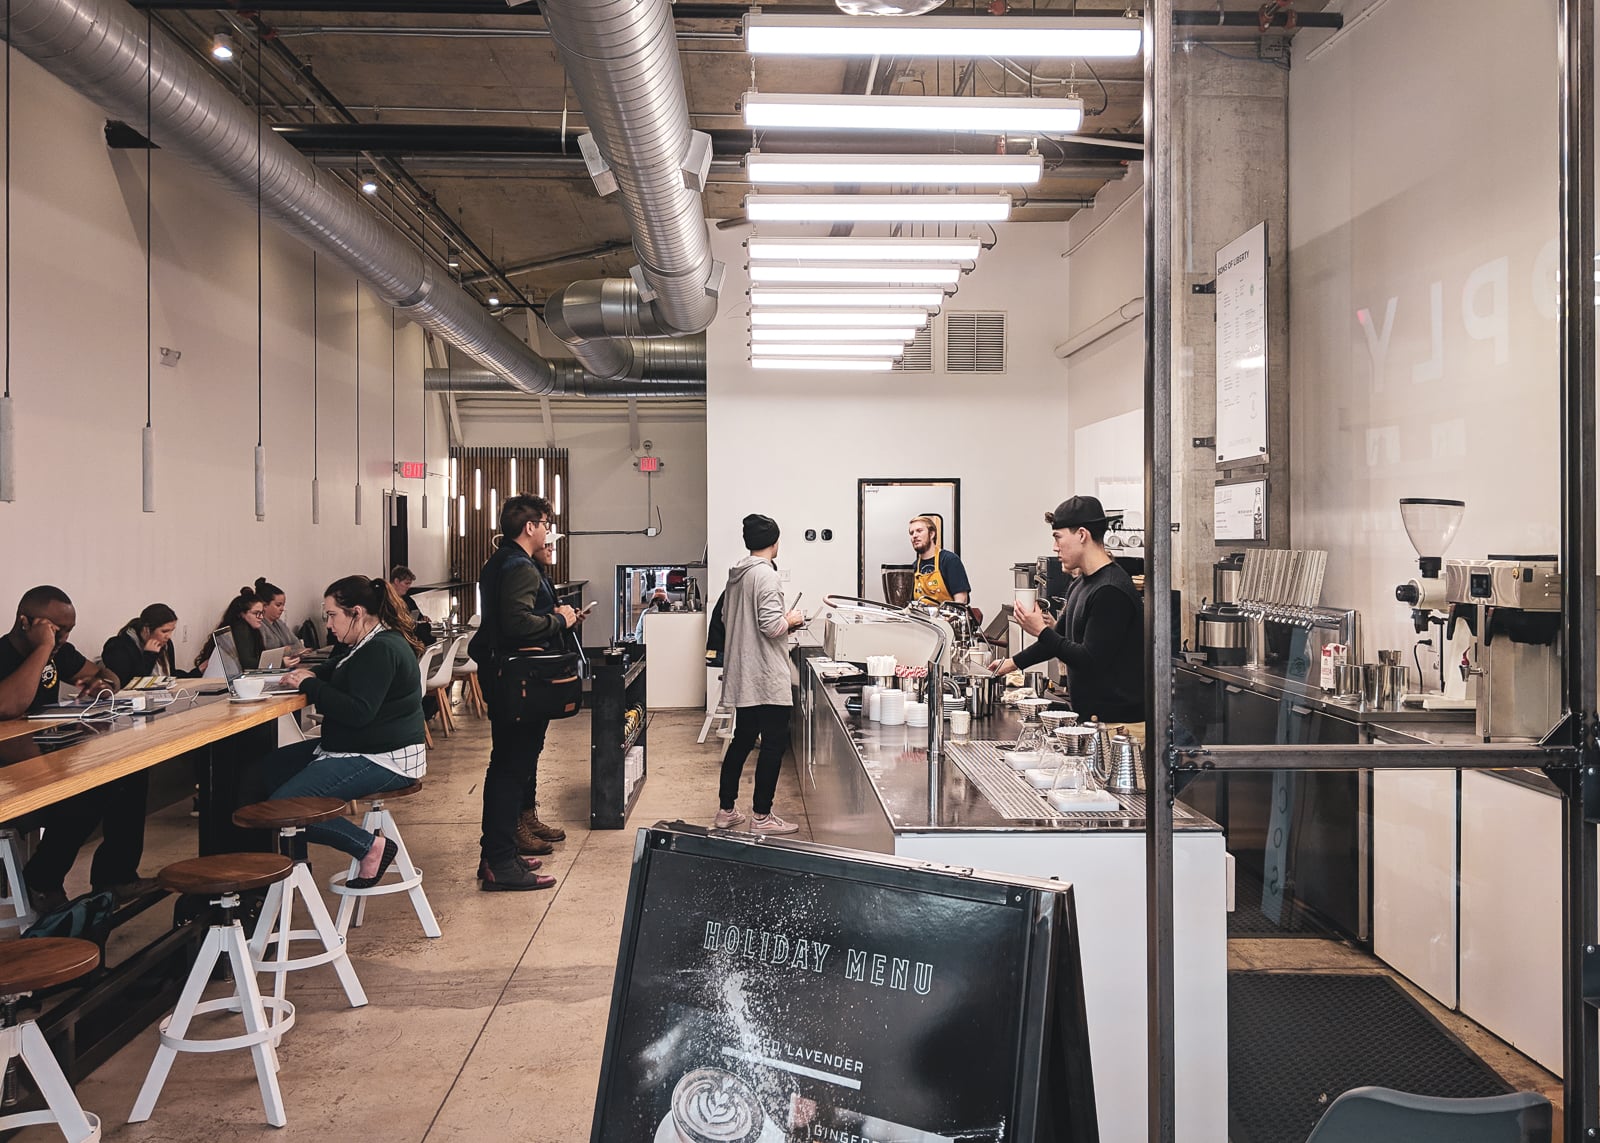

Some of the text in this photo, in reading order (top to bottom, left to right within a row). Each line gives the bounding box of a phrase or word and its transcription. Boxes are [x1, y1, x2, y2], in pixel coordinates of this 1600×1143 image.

[403, 462, 424, 478] EXIT
[641, 457, 657, 471] EXIT
[703, 920, 933, 995] HOLIDAY MENU
[787, 1046, 864, 1073] LAVENDER
